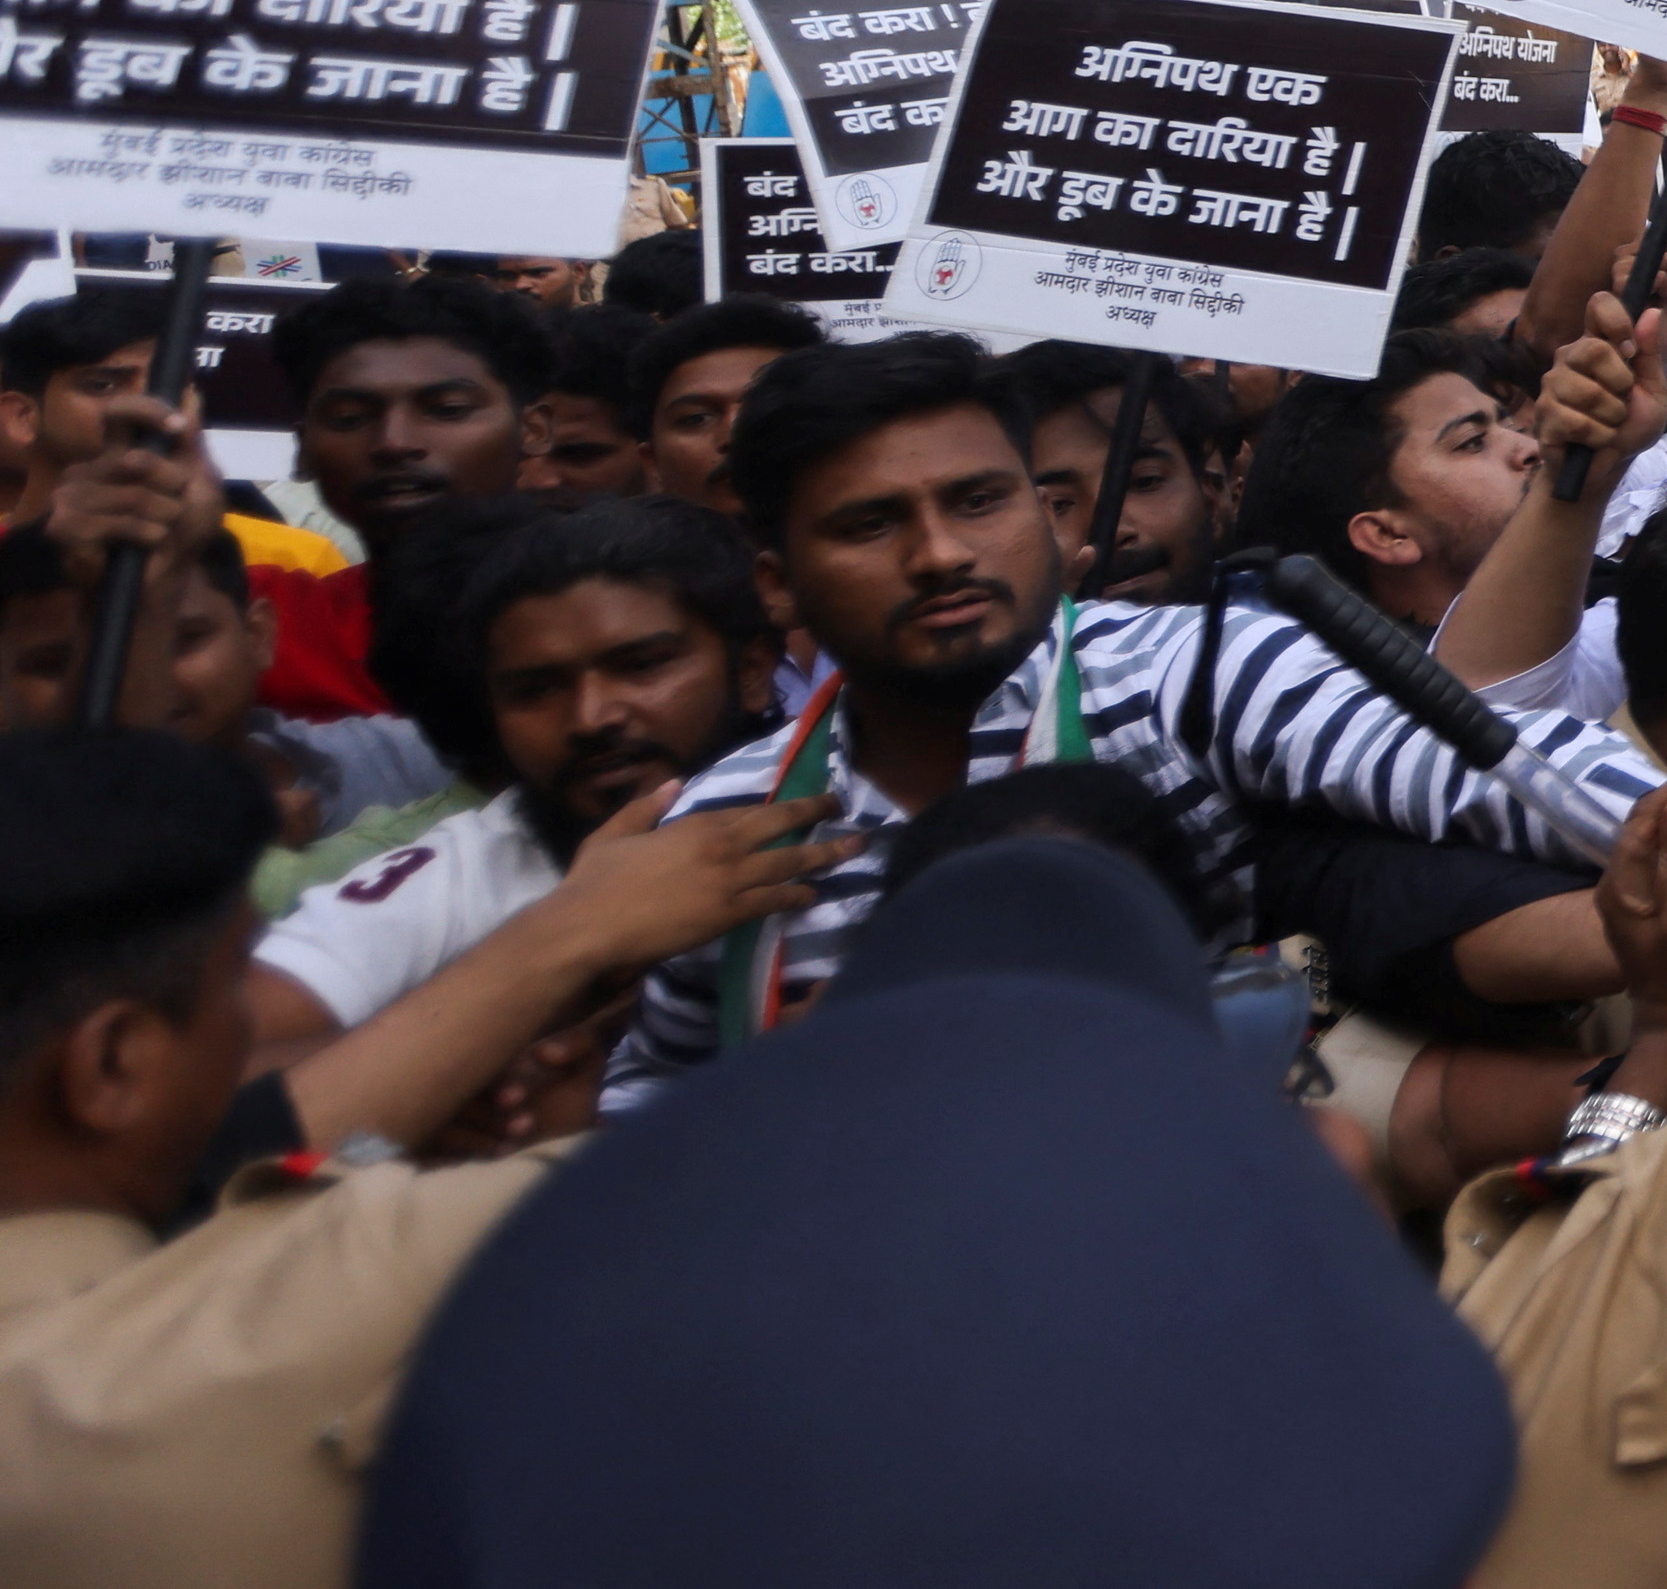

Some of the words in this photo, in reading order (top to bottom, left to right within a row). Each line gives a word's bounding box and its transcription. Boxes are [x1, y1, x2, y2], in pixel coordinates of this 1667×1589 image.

[791, 10, 857, 41] बंद
[858, 6, 936, 35] करा
[1459, 26, 1516, 60] अग्निपथ
[1517, 29, 1558, 63] योजना
[74, 37, 194, 101] डूब
[202, 34, 297, 91] के
[305, 56, 471, 104] जाना
[819, 48, 958, 87] अग्निपथ
[1075, 40, 1240, 97] अग्निपथ
[1246, 66, 1328, 106] एक
[1454, 70, 1478, 102] बंद
[834, 100, 897, 134] बंद
[1002, 99, 1090, 141] आग
[1094, 111, 1162, 150] का
[743, 171, 799, 197] बंद
[976, 150, 1055, 201] और
[1056, 170, 1125, 222] डूब
[1129, 168, 1184, 216] के
[1188, 188, 1292, 234] जाना
[746, 248, 801, 275] बंद
[1065, 248, 1101, 273] मुंबई
[1102, 251, 1141, 278] प्रदेश
[1144, 263, 1173, 285] युवा
[1177, 264, 1225, 288] कांग्रेस
[1034, 270, 1091, 294] आमदार
[1095, 277, 1147, 302] झीशान
[1150, 287, 1185, 308] बाबा
[207, 311, 277, 334] करा
[1105, 304, 1157, 329] अध्यक्ष
[336, 846, 437, 905] 3
